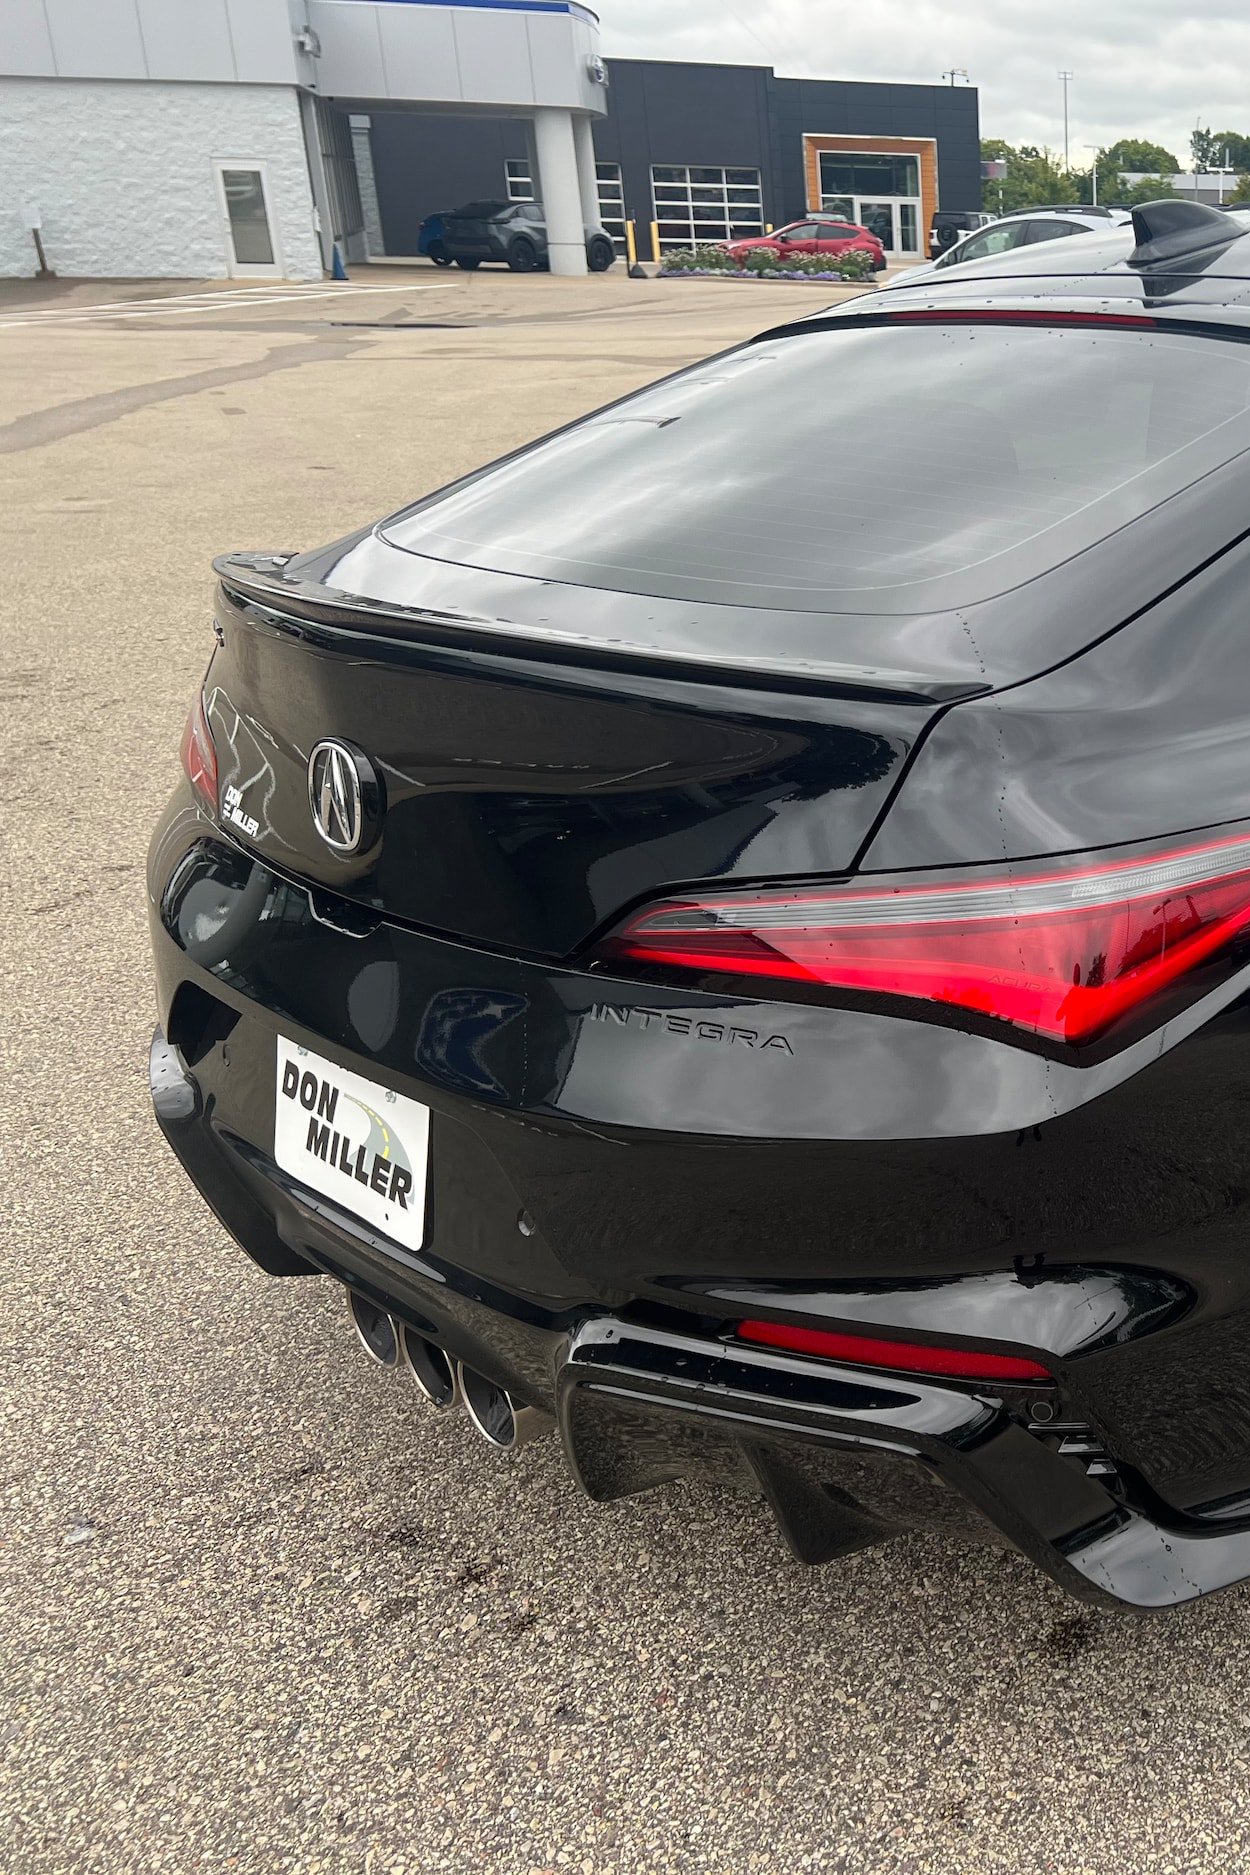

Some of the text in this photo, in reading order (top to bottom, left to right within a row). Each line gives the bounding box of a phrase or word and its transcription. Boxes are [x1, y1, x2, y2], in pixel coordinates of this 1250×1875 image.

[225, 784, 243, 808] DON
[230, 806, 260, 837] MILLER
[590, 1002, 794, 1057] INTEGRA
[282, 1059, 339, 1124] DON
[306, 1115, 413, 1210] MILLER
